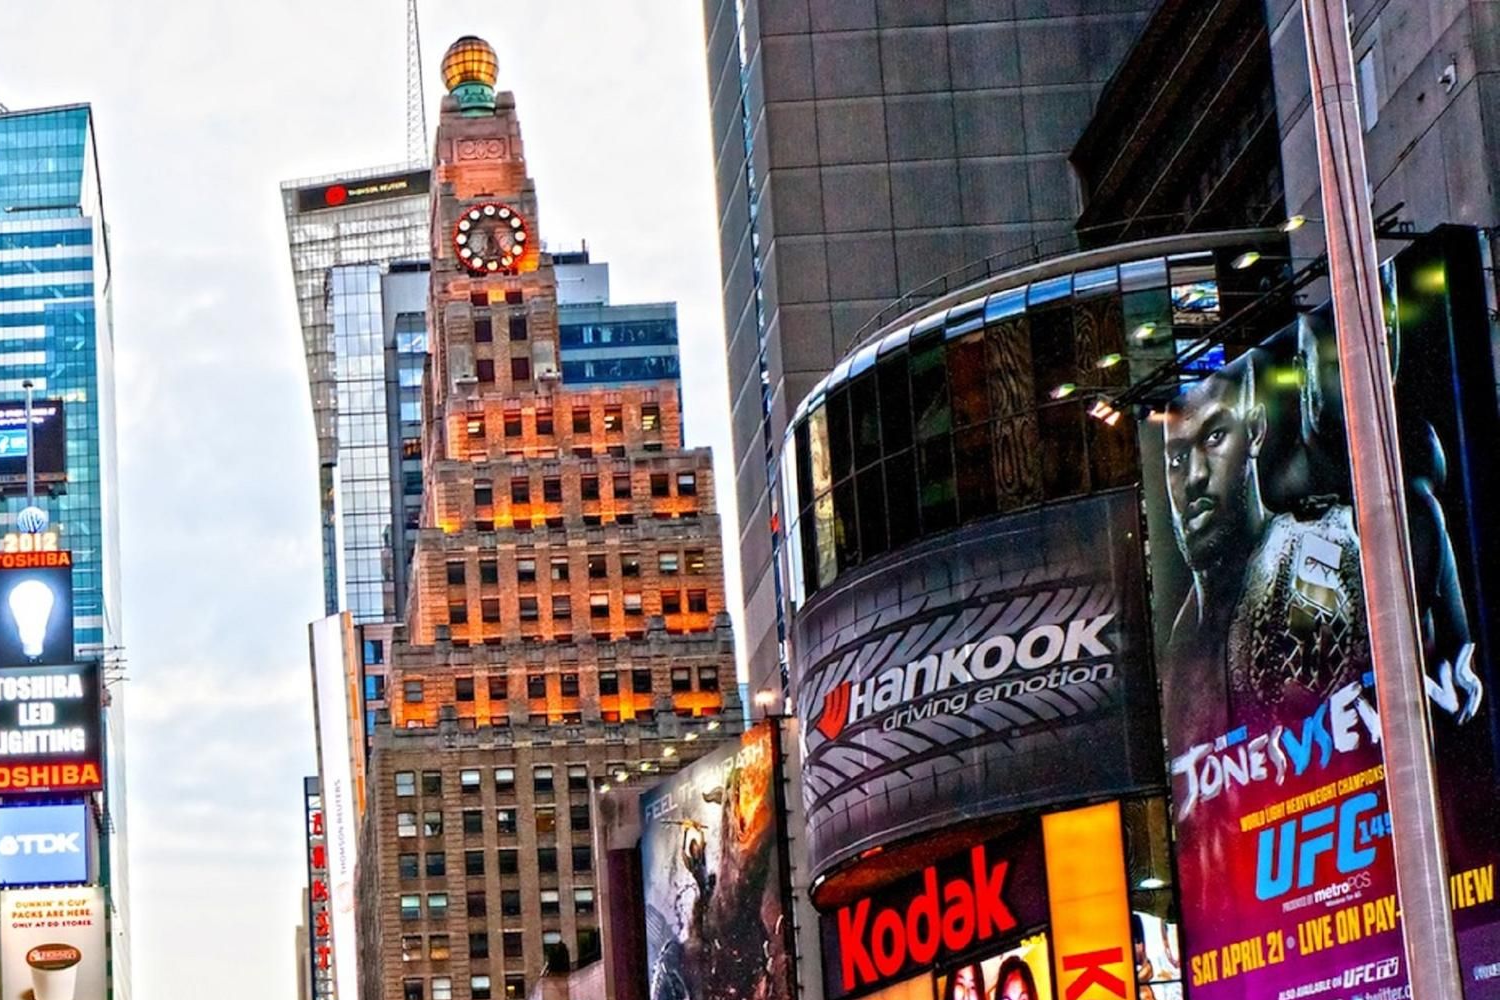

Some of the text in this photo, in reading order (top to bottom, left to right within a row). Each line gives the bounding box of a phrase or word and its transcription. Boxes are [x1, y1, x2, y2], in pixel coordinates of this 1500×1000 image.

[4, 532, 58, 553] 2012
[882, 661, 1114, 732] driving emotion
[18, 702, 55, 726] LED
[1171, 725, 1286, 822] JONES
[1282, 703, 1333, 775] VS
[645, 793, 678, 823] FEEL
[17, 832, 80, 853] TDK
[1255, 791, 1378, 902] UFC
[1314, 871, 1372, 903] metroPCS
[12, 909, 94, 919] PACKS ARE HERE.
[12, 921, 33, 929] ONLY
[35, 920, 45, 928] AT
[837, 845, 1016, 992] Kodak
[1191, 950, 1218, 987] SAT
[1221, 937, 1266, 979] APRIL
[1267, 929, 1285, 964] 21
[1298, 915, 1334, 955] LIVE
[1335, 906, 1362, 945] ON
[1296, 979, 1331, 999] AVAILABLE
